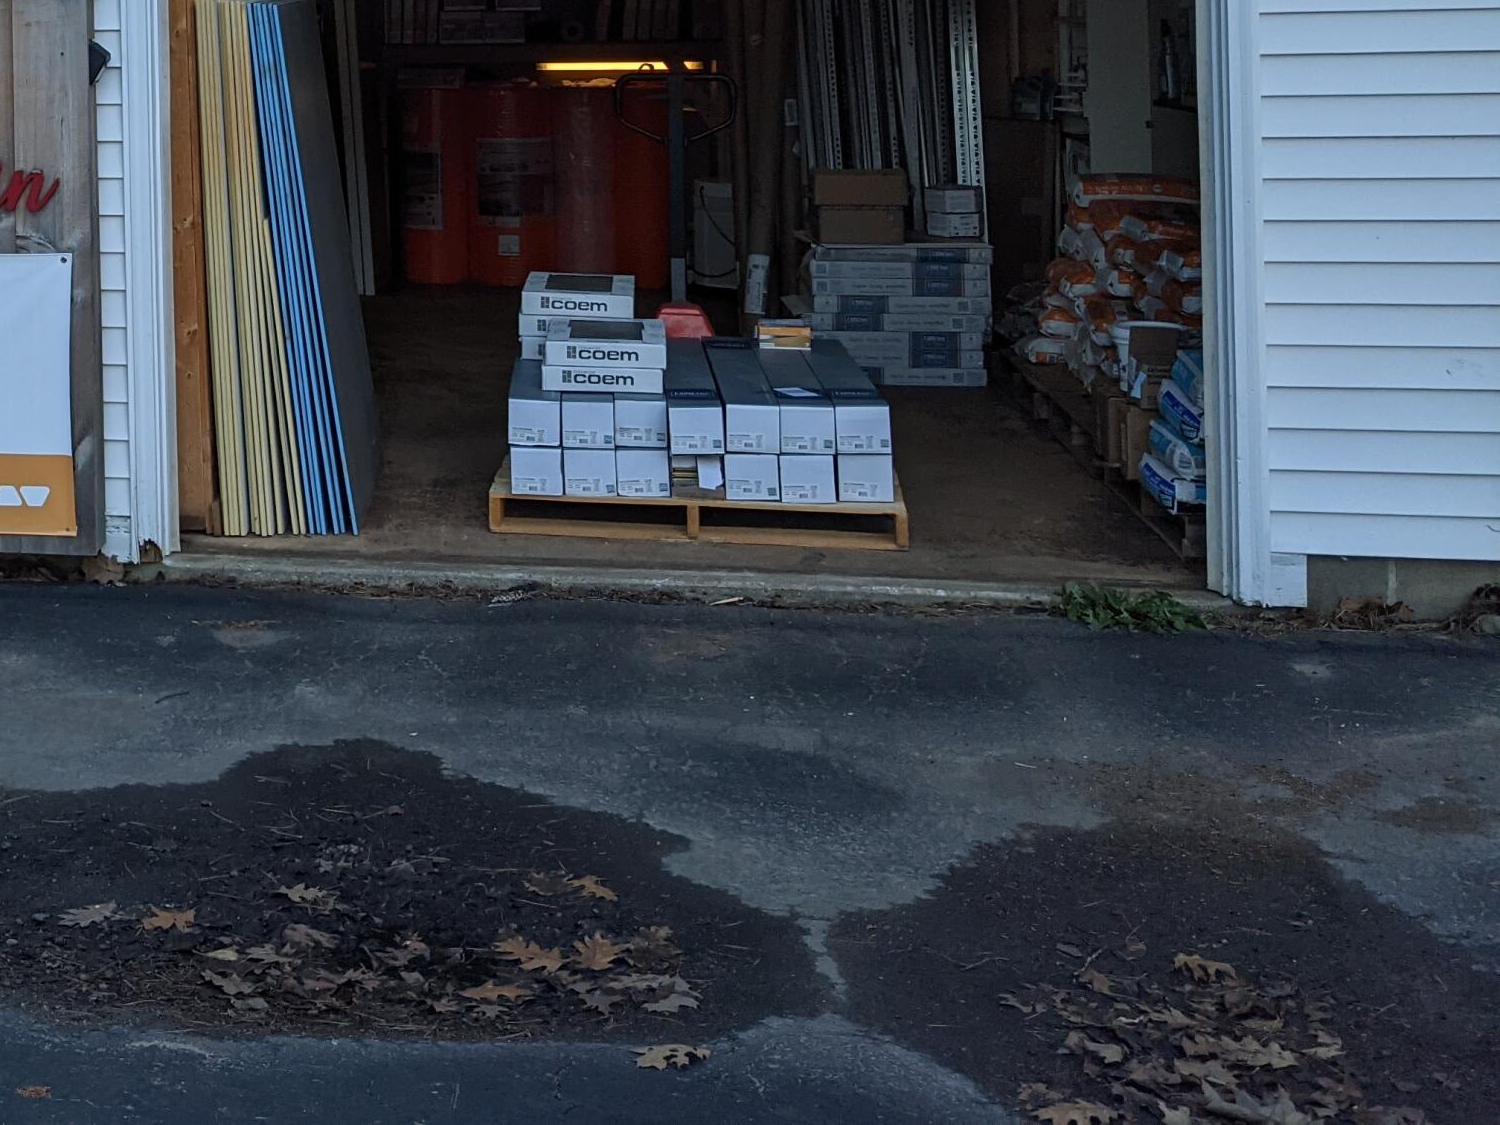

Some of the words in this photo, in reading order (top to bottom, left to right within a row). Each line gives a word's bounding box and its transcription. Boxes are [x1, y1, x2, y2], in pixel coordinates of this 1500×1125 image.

[551, 300, 608, 312] coem
[578, 349, 639, 362] coem
[573, 373, 635, 386] coem
